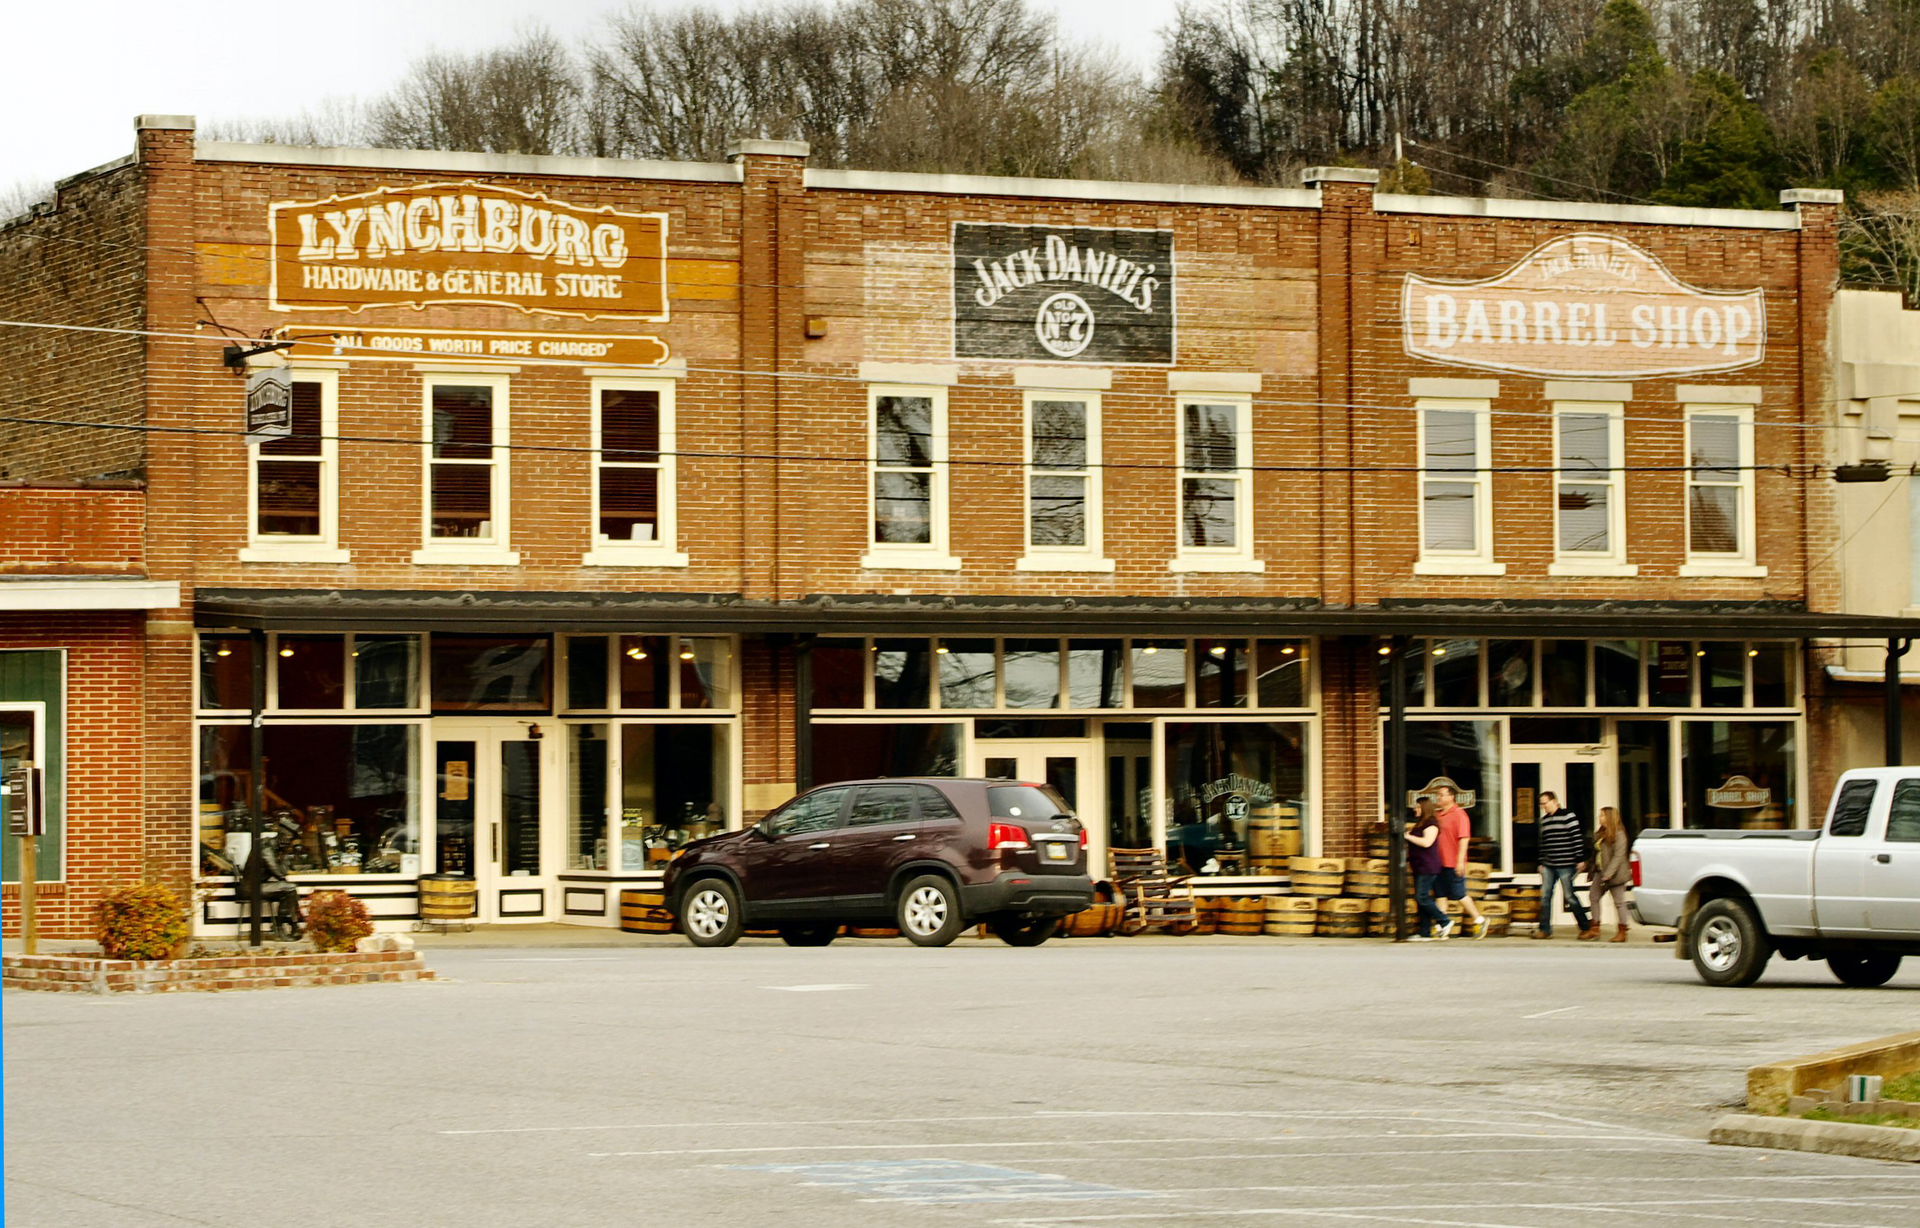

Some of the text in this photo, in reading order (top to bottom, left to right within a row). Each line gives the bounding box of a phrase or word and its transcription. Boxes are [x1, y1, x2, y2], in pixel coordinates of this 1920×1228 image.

[298, 195, 628, 268] LYNCHBURG
[303, 265, 622, 298] HARDWARE & GENERAL STORE
[973, 234, 1160, 314] JACK DANIEL'S
[1053, 300, 1077, 311] OLD
[1423, 294, 1752, 356] BARREL SHOP
[370, 336, 423, 352] GOODS
[428, 338, 483, 353] WORTH
[489, 340, 533, 355] PRICE
[538, 341, 614, 357] CHARGED"
